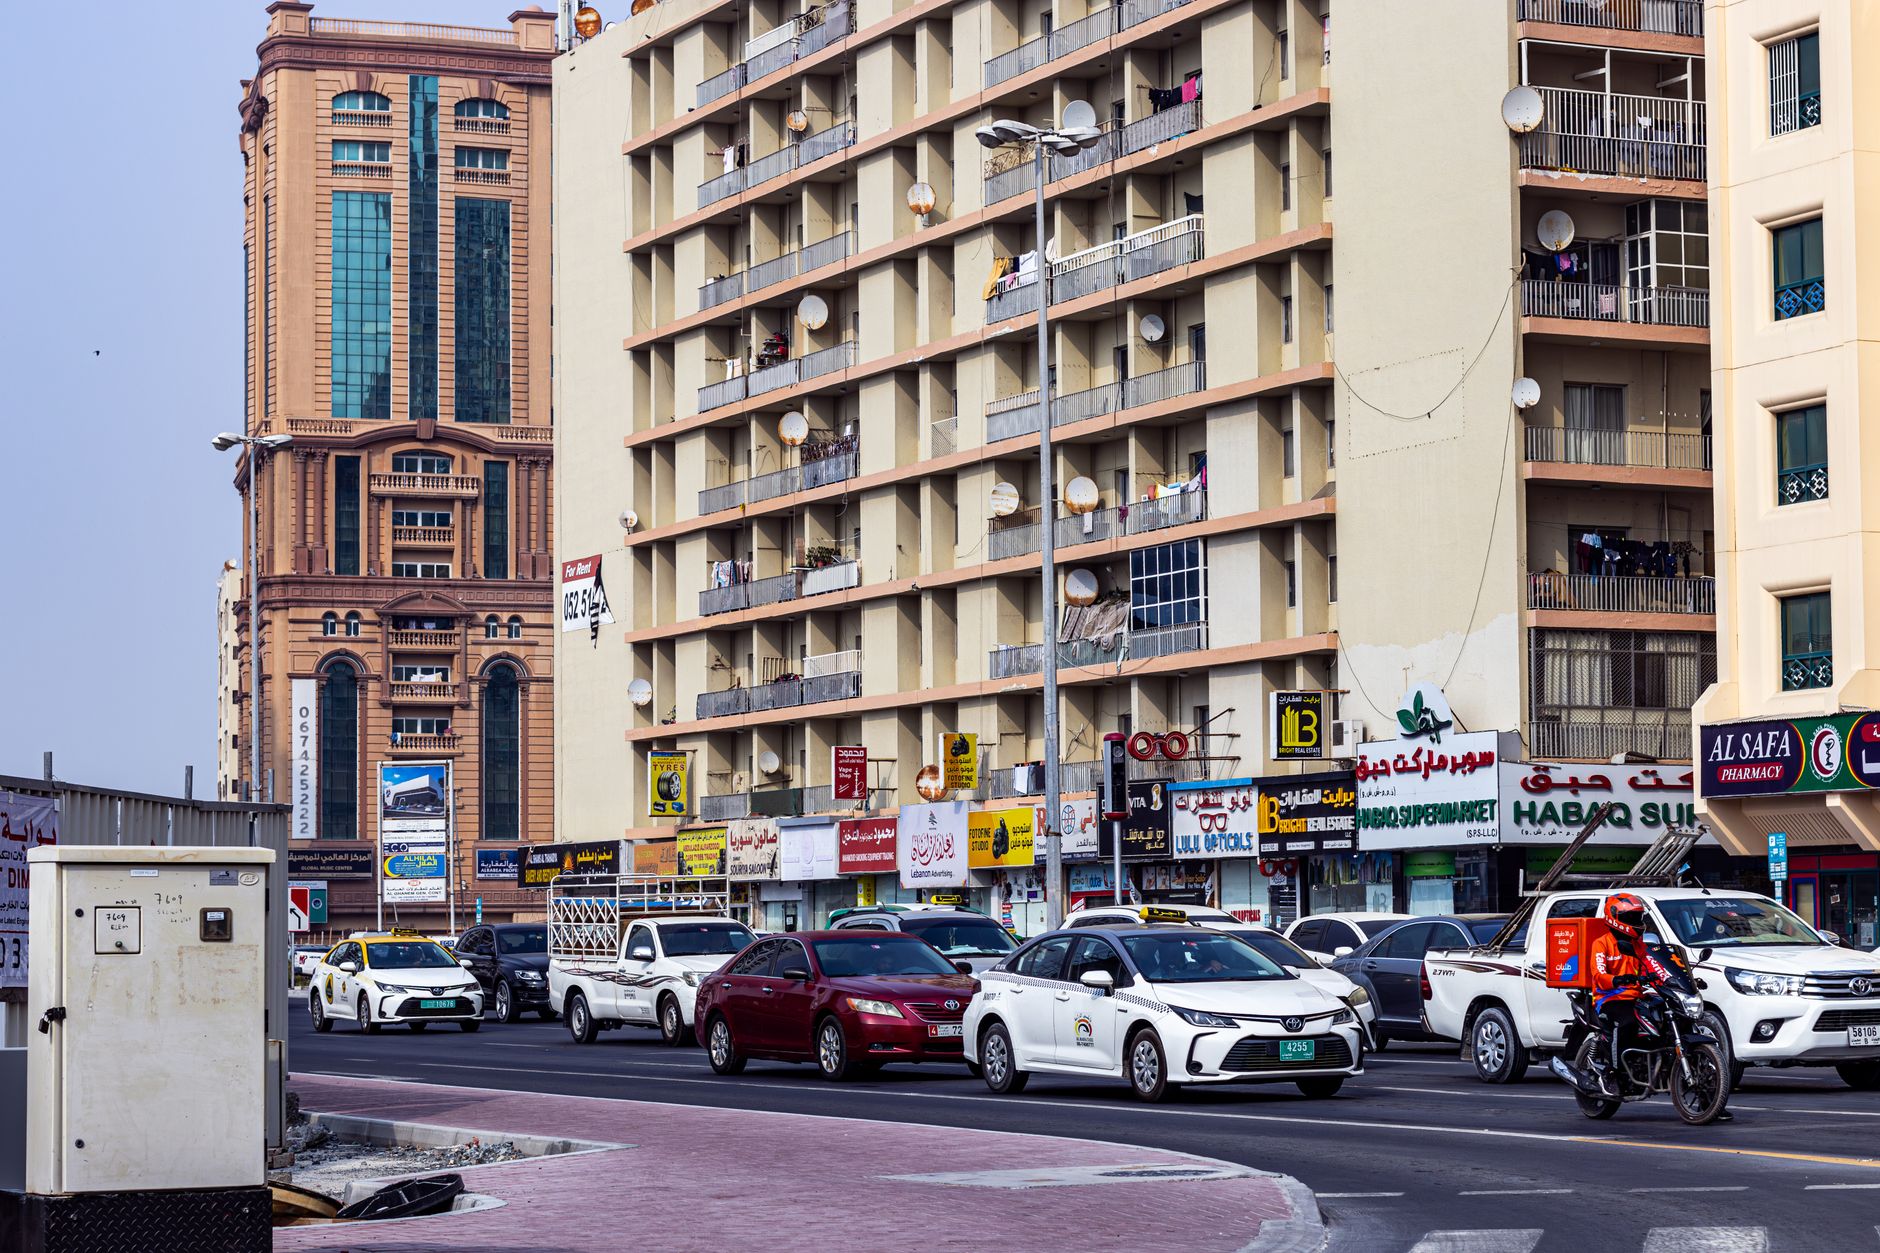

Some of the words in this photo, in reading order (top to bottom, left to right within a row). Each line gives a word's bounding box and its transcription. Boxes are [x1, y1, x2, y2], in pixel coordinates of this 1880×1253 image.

[565, 564, 576, 578] For
[576, 561, 592, 576] Rent
[564, 590, 579, 621] 052
[1708, 734, 1736, 761] AL
[1739, 730, 1791, 759] SAFA
[1356, 754, 1391, 782] حبق
[1393, 746, 1449, 780] ماركت
[1449, 751, 1495, 775] سوبر
[1520, 766, 1614, 796] حبق
[1721, 766, 1783, 781] PHARMACY
[1279, 818, 1307, 833] BRIGHT
[1307, 817, 1326, 832] REAL
[1326, 816, 1355, 831] ESTATE
[1356, 805, 1400, 830] HABAQ
[1400, 799, 1498, 828] SUPERMARKET
[1513, 800, 1633, 831] HABAQ
[730, 831, 753, 851] سوريا
[754, 828, 777, 850] صالون
[969, 828, 991, 839] FOTOFINE
[1176, 834, 1200, 853] LULU
[1204, 832, 1253, 852] OPTICALS
[384, 844, 408, 852] ECO
[972, 841, 989, 851] STUDIO
[911, 869, 930, 878] Lebanon
[1852, 1026, 1877, 1037] 58106
[1287, 1041, 1308, 1052] 4255
